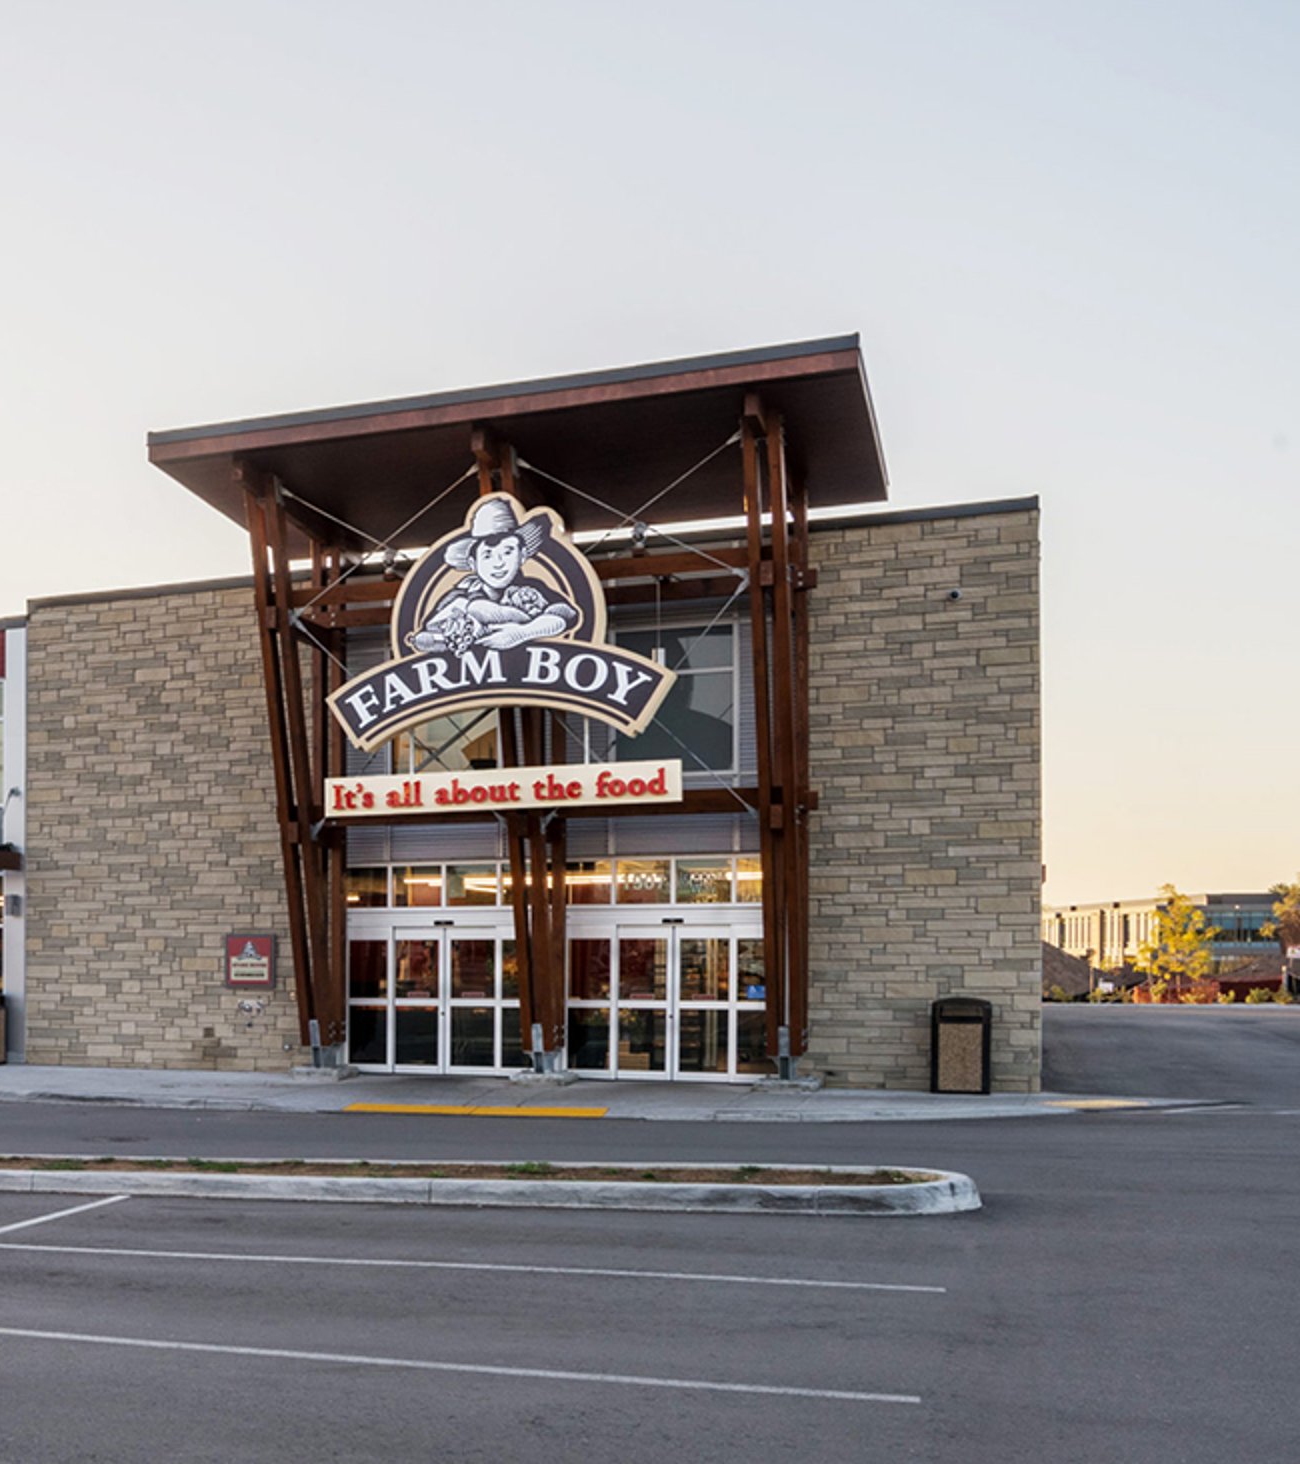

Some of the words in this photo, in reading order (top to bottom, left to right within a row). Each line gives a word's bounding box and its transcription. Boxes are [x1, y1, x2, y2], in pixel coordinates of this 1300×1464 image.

[345, 649, 507, 728] FARM
[522, 646, 653, 706] BOY
[333, 783, 374, 811] It's
[386, 780, 422, 809] all
[435, 778, 520, 806] about
[533, 773, 582, 801] the
[595, 767, 668, 799] food
